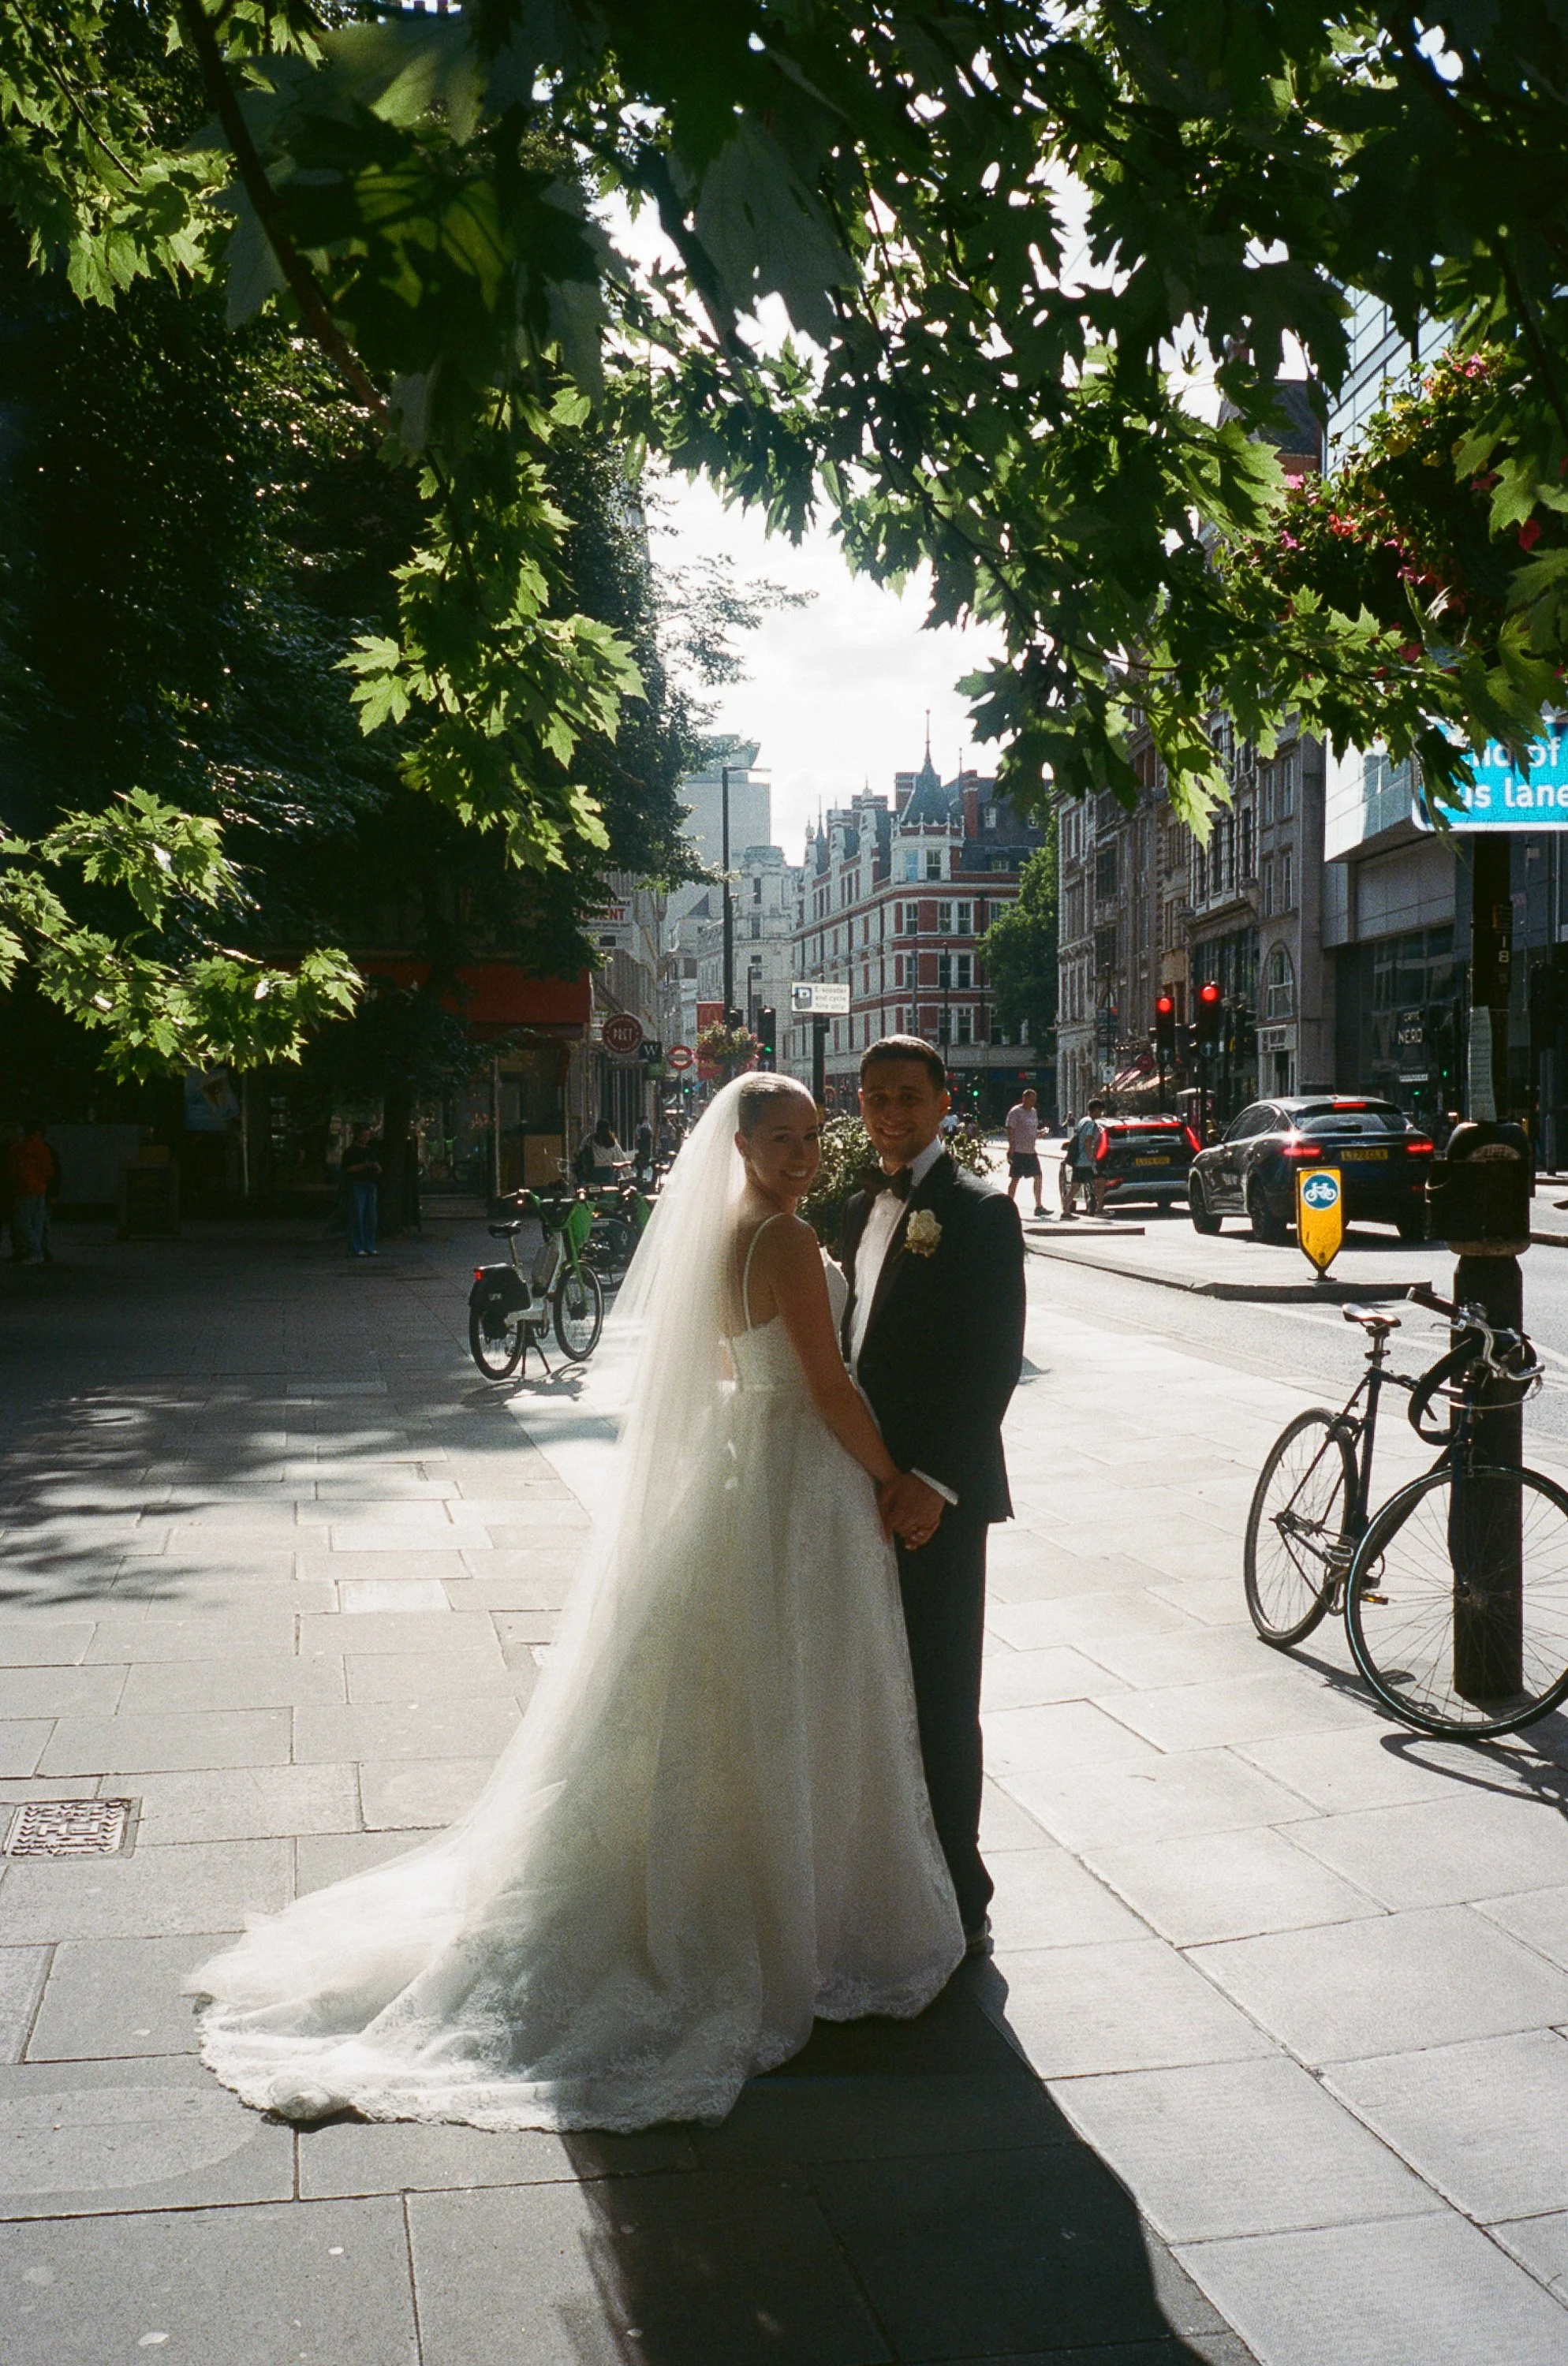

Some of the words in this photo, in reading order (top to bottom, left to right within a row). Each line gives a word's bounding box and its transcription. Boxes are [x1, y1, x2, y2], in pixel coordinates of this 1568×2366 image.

[1527, 737, 1562, 768] of
[1504, 775, 1568, 808] lane
[1398, 1028, 1423, 1045] NERO
[644, 1045, 659, 1055] W
